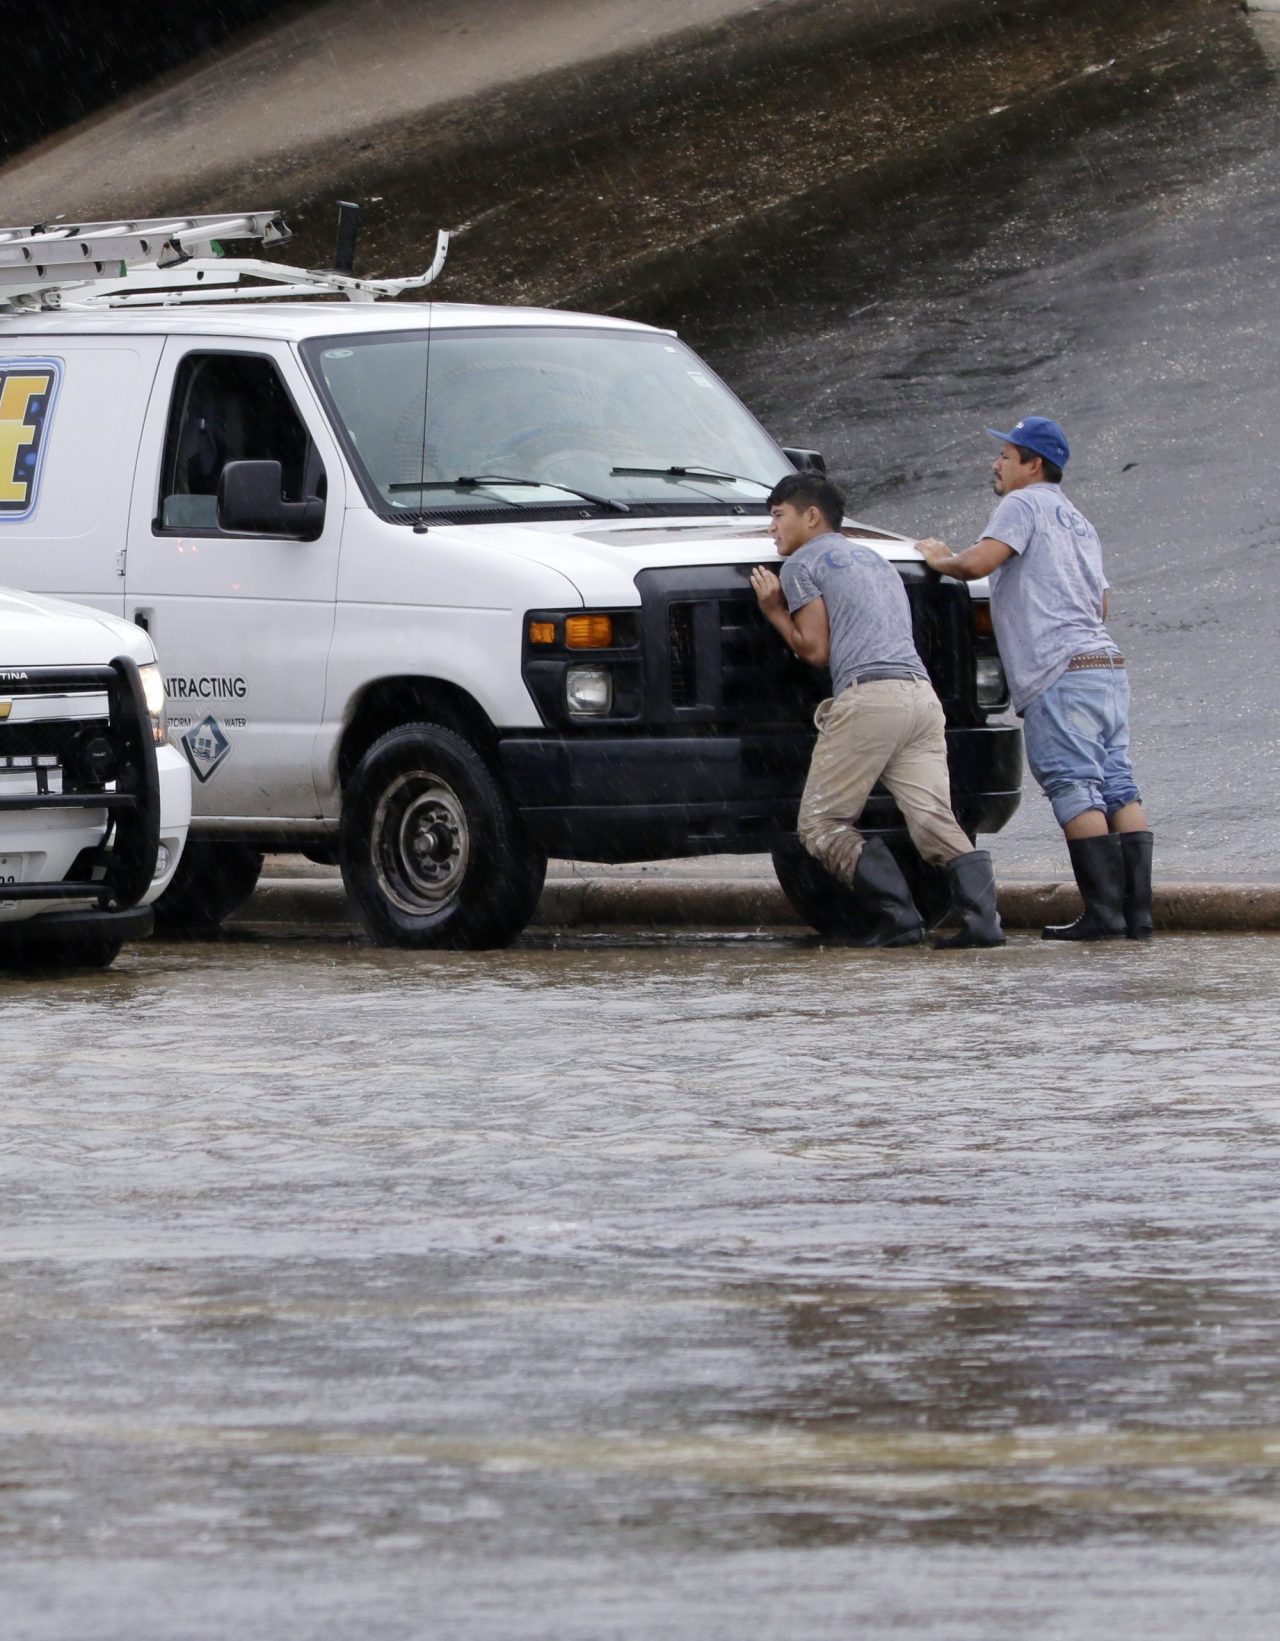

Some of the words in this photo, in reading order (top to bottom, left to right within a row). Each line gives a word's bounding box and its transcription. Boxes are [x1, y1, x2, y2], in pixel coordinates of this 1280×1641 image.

[163, 677, 247, 698] NTRACTING
[167, 717, 192, 728] STORM
[223, 718, 247, 728] WATER
